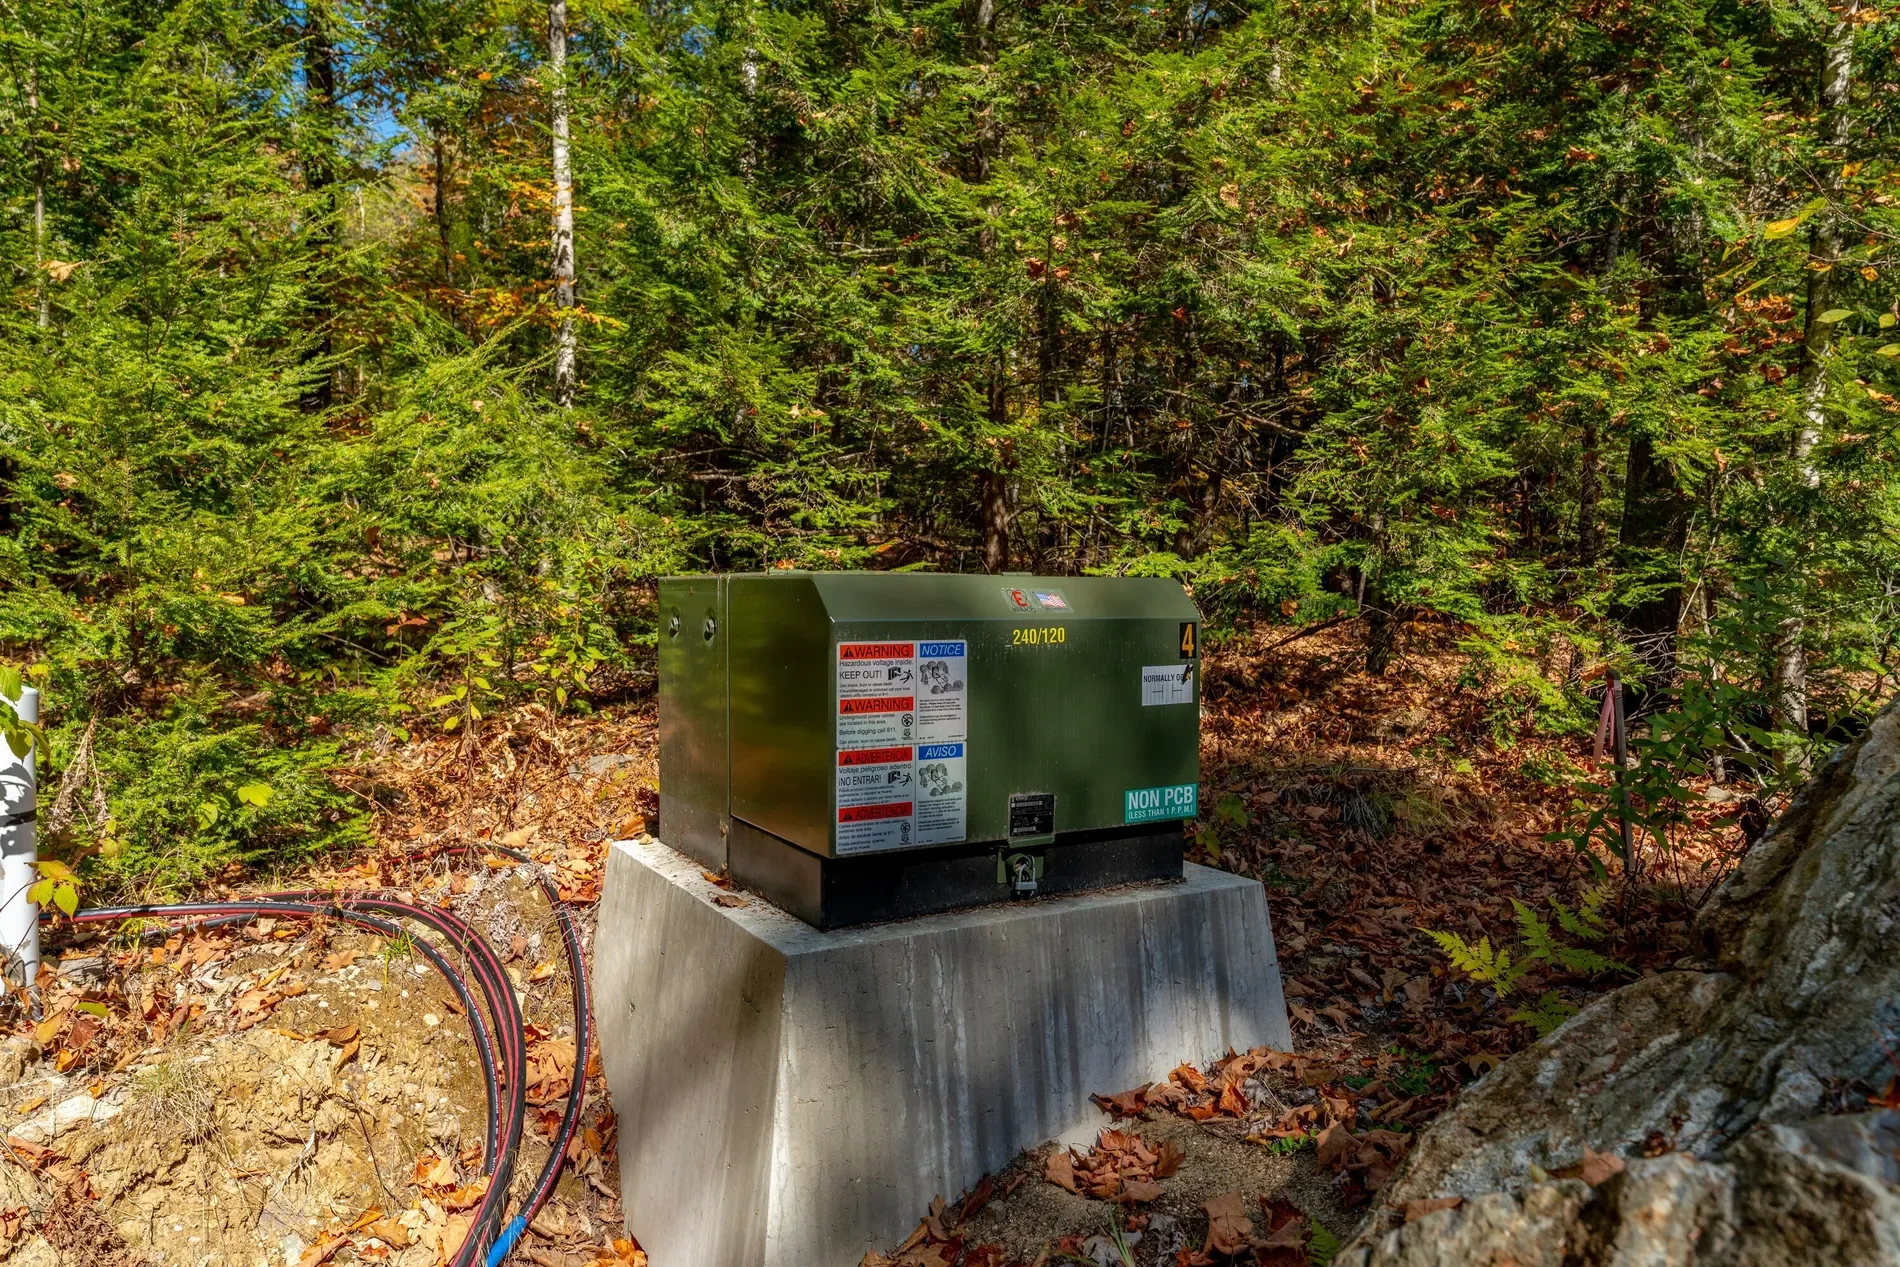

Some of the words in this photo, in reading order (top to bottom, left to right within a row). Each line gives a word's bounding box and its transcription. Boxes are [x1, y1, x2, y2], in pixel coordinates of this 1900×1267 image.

[1013, 627, 1065, 645] 240/120
[1182, 624, 1194, 657] 4
[855, 645, 910, 657] WARNING
[922, 644, 962, 656] NOTICE
[840, 670, 860, 680] KEEP
[863, 670, 882, 678] OUT!
[1144, 674, 1175, 682] NORMALLY
[855, 699, 910, 712] WARNING
[856, 750, 908, 764] ADVERTENCIA
[925, 746, 957, 758] AVISO
[853, 774, 881, 785] ENTRAR!
[1128, 790, 1160, 810] NON
[1164, 786, 1193, 806] PCB
[856, 806, 908, 820] ADVERTENCIA
[1128, 810, 1146, 820] (LESS
[1148, 808, 1164, 817] THAN
